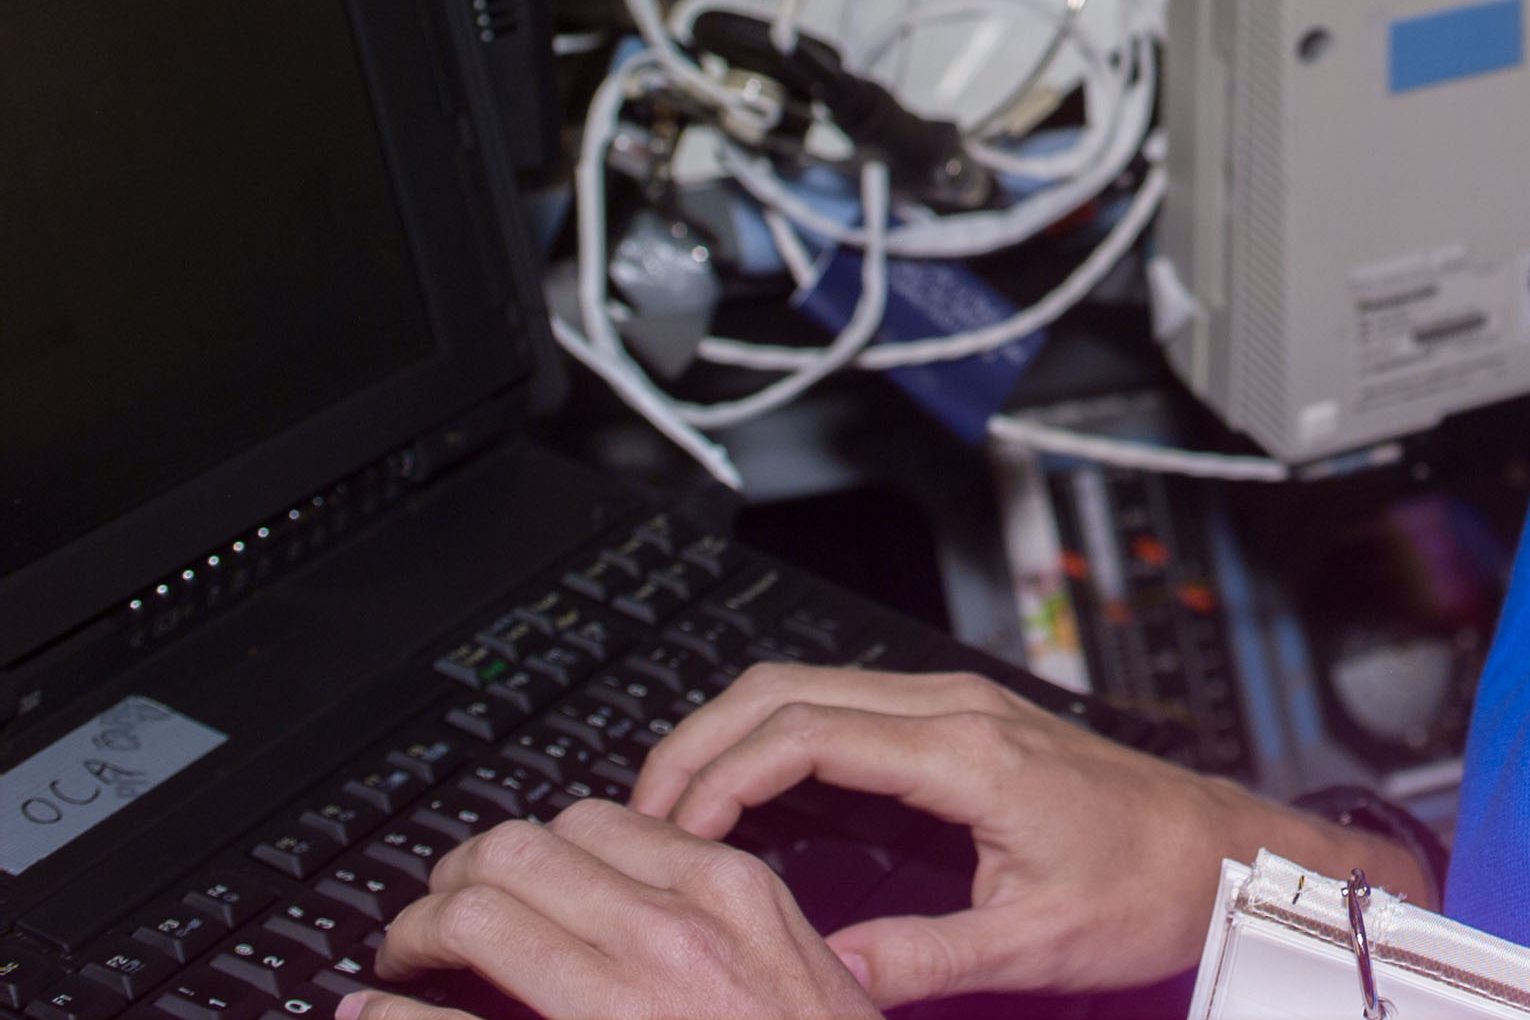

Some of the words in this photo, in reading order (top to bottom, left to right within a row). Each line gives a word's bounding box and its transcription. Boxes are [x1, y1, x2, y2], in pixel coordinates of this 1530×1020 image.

[21, 759, 146, 824] OCA
[158, 918, 181, 933] F3
[314, 917, 336, 930] 3
[105, 954, 129, 969] F2
[262, 955, 285, 969] 2
[333, 957, 362, 974] W
[52, 994, 73, 1008] F1
[208, 997, 227, 1009] 1
[284, 998, 312, 1014] Q
